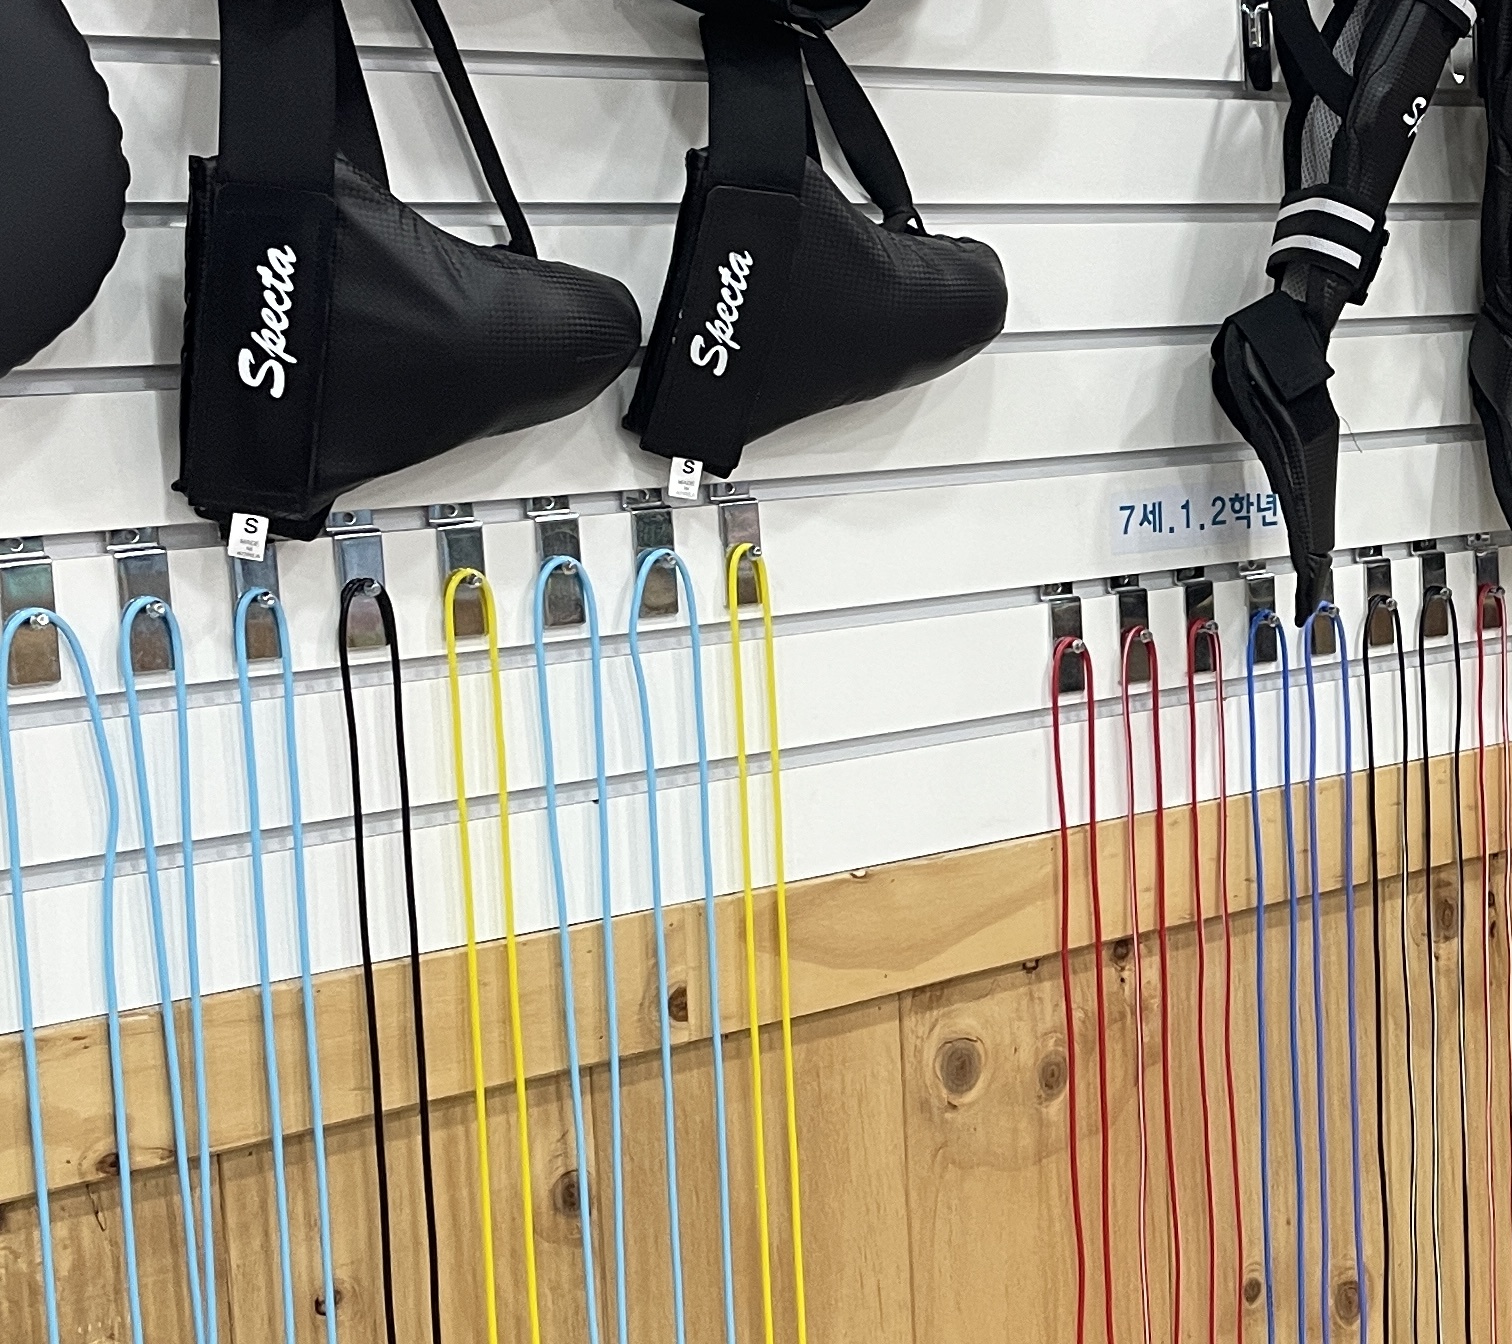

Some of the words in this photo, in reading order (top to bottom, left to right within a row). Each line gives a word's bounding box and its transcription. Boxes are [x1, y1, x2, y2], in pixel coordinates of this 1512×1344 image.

[238, 244, 297, 399] Specta
[690, 250, 753, 377] Specta
[683, 459, 696, 474] S
[244, 517, 259, 534] S
[1119, 492, 1279, 535] 7세.1.2학년
